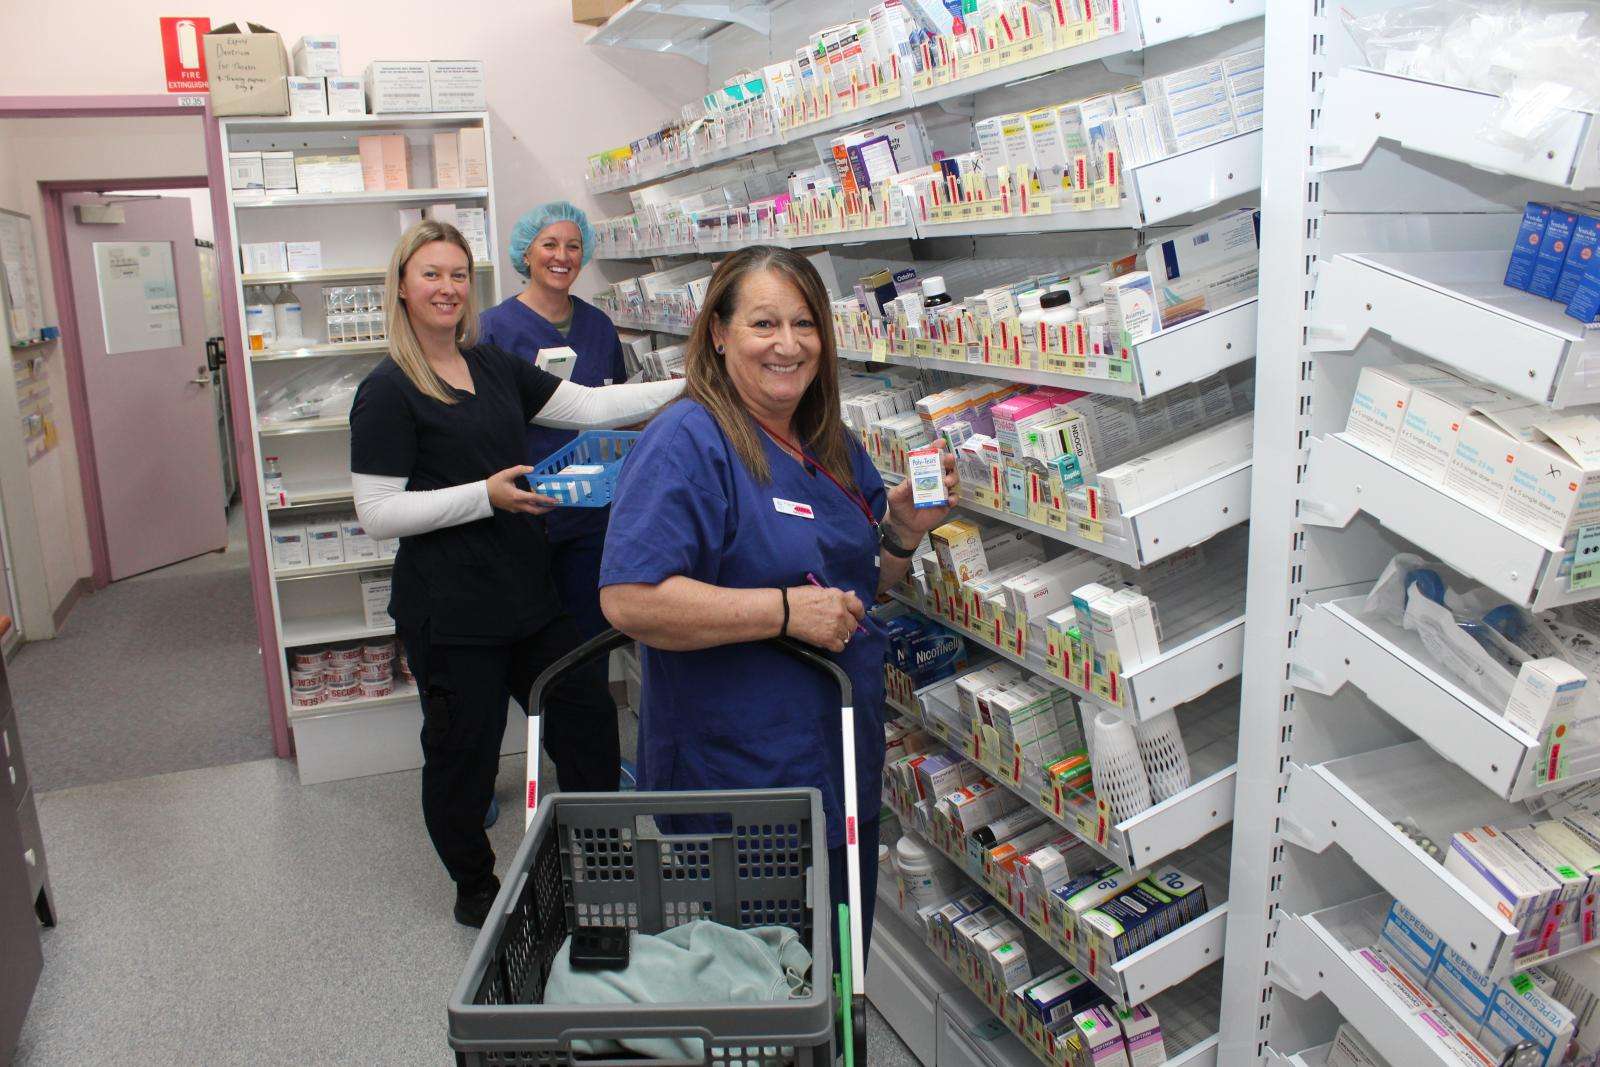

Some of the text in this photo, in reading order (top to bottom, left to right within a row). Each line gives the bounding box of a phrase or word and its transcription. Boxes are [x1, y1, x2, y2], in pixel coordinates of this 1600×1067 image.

[181, 71, 201, 79] FIRE
[1071, 423, 1084, 458] INDOCID
[912, 456, 937, 466] Poly-Tears
[1159, 872, 1185, 889] flo
[1399, 904, 1435, 941] VEPESID
[1450, 950, 1488, 988] VEPESID
[1504, 997, 1546, 1038] VEPESID
[1524, 991, 1562, 1028] VEPESID
